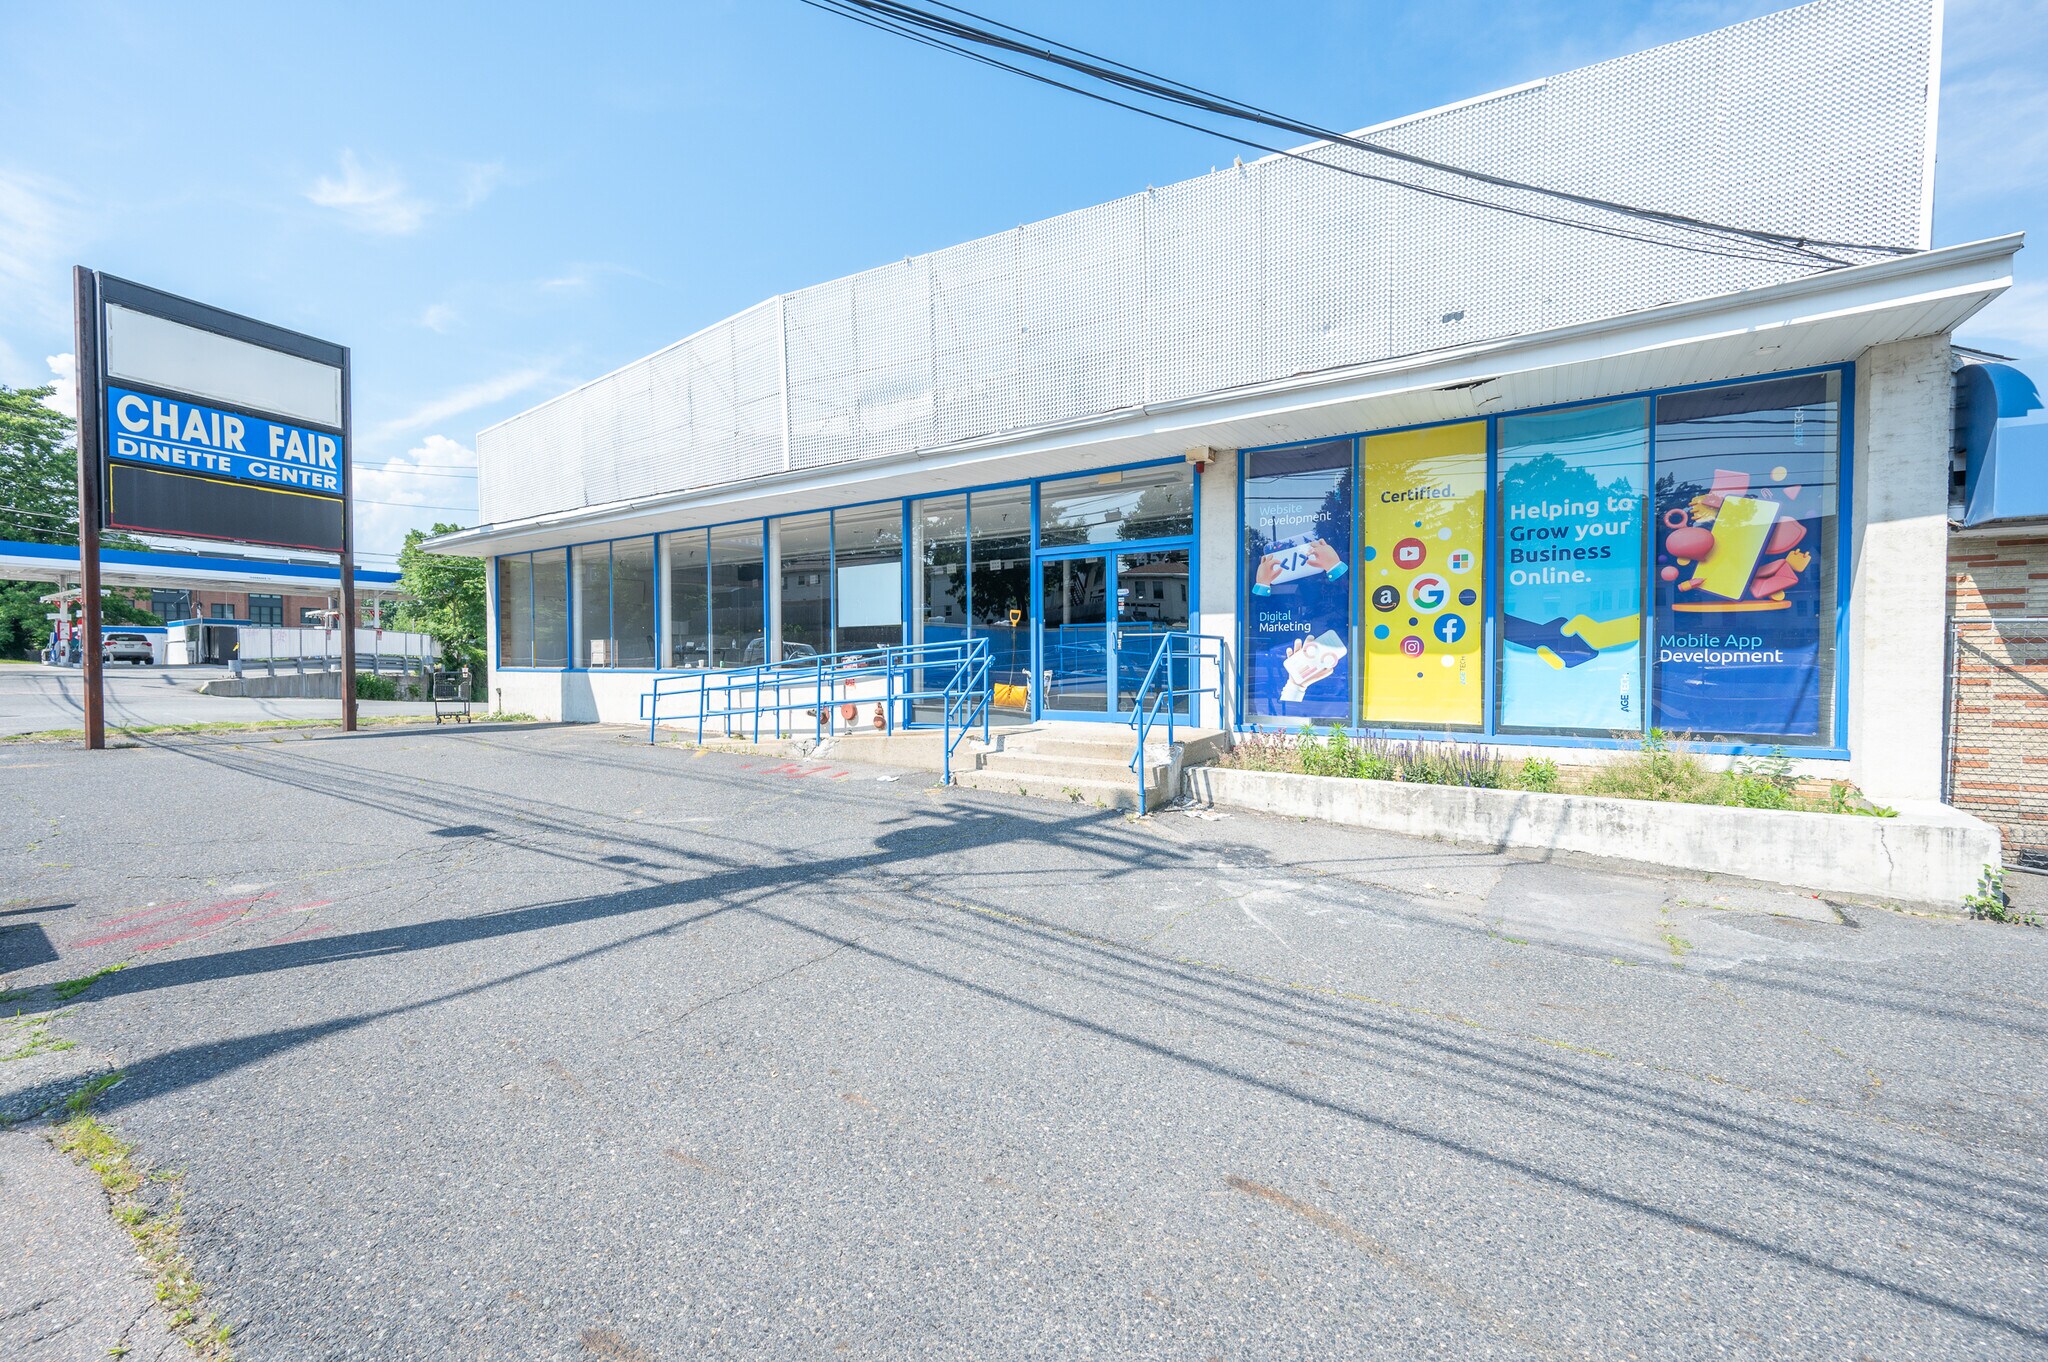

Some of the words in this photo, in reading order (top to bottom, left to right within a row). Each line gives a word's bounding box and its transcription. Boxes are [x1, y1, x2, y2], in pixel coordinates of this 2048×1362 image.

[117, 394, 247, 452] CHAIR
[268, 425, 337, 470] FAIR
[117, 438, 231, 473] DINETTE
[248, 462, 337, 490] CENTER
[1380, 484, 1456, 505] Certified.
[1259, 503, 1303, 516] Website
[1510, 498, 1599, 523] Helping
[1607, 494, 1634, 512] to
[1259, 511, 1332, 527] Development
[1510, 525, 1569, 543] Grow
[1574, 519, 1631, 542] your
[1510, 544, 1611, 564] Business
[1509, 569, 1592, 586] Online.
[1259, 610, 1292, 624] Digital
[1259, 621, 1312, 633] Marketing
[1660, 633, 1720, 648] Mobile
[1725, 634, 1763, 652] App
[1660, 648, 1783, 667] Development
